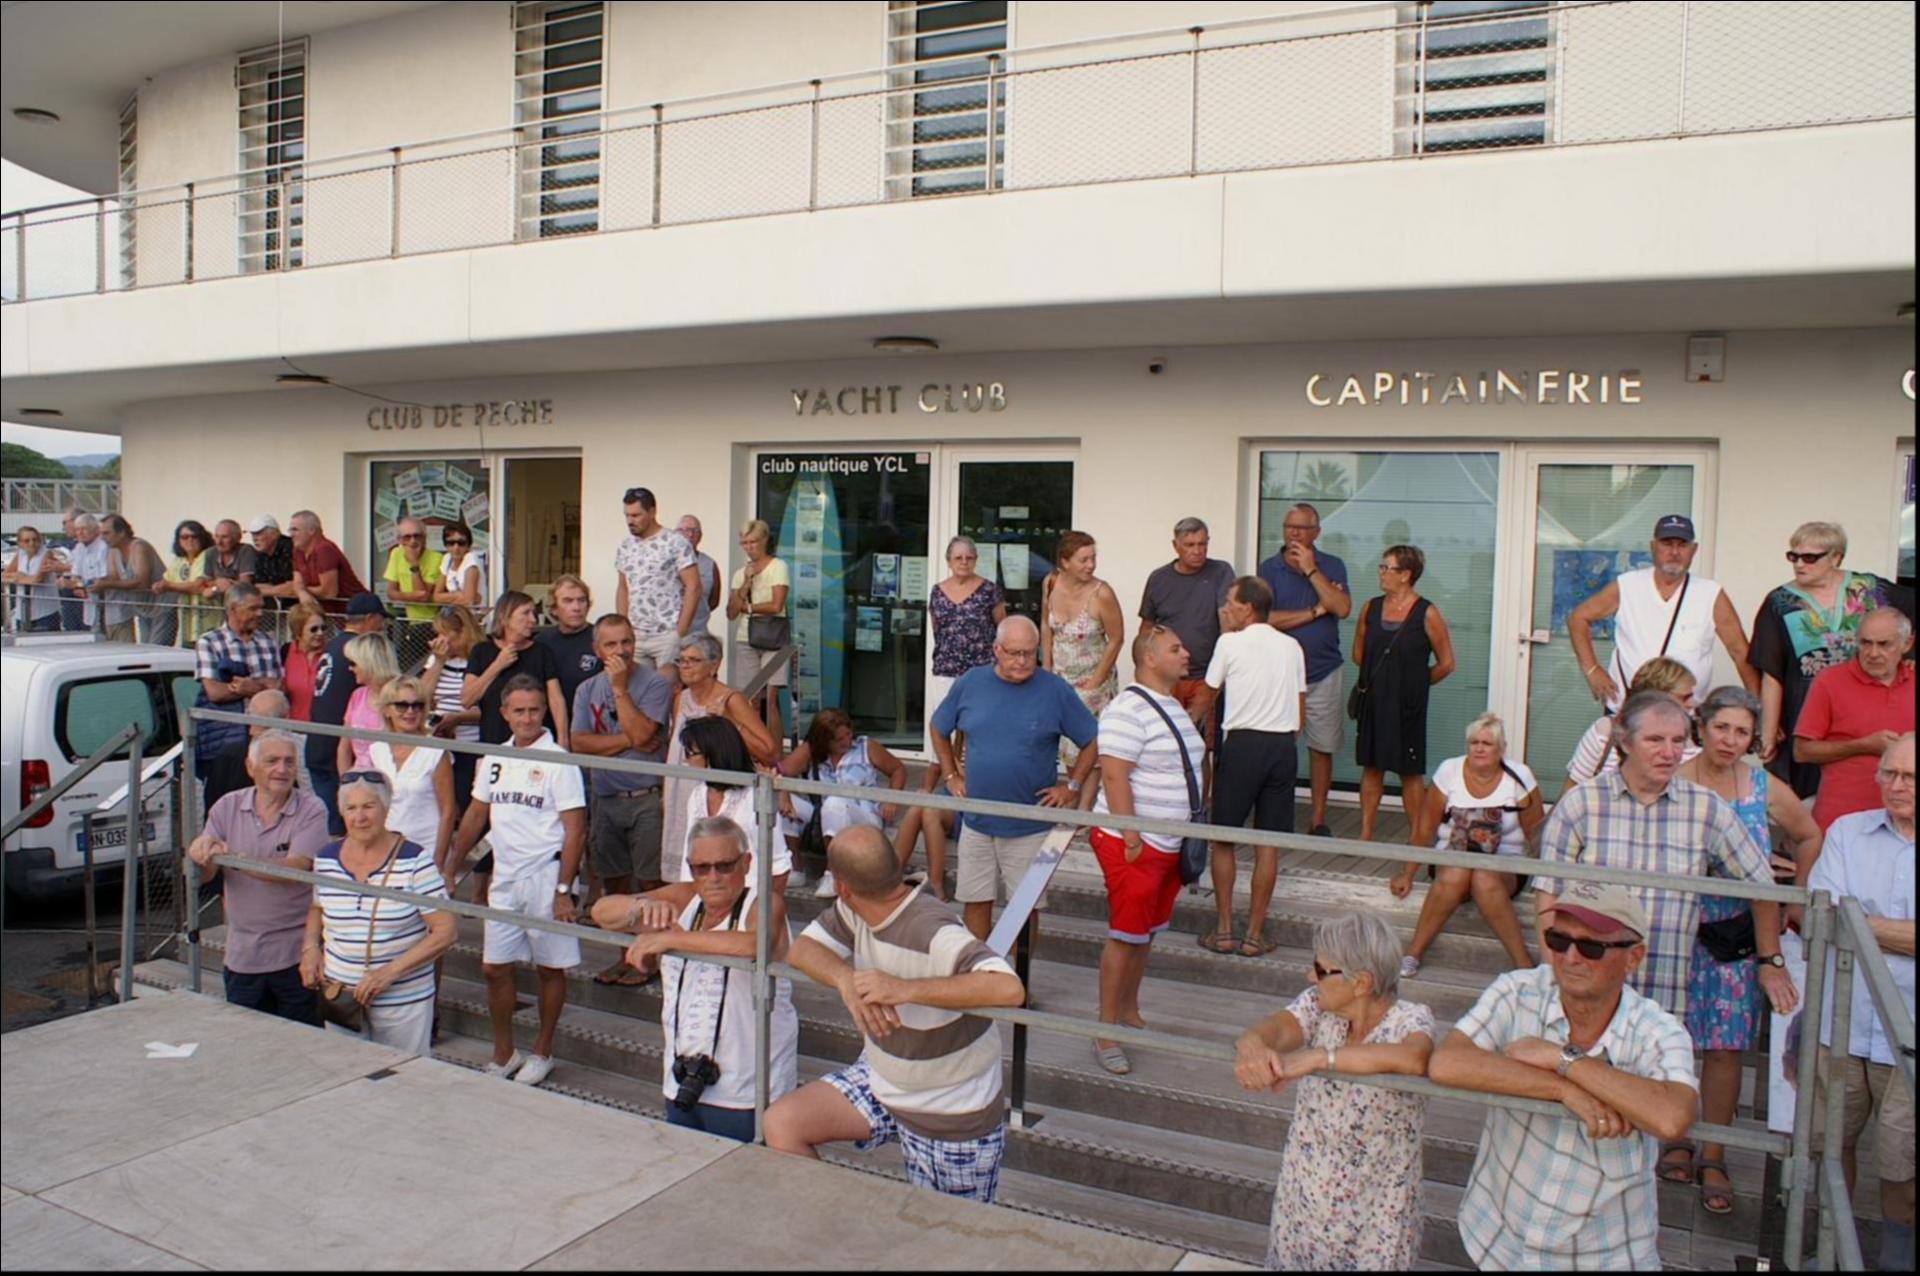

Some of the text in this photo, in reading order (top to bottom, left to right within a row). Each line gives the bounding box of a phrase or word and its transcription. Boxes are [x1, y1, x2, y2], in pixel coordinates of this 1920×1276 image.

[791, 382, 1008, 416] YACHT CLUB
[1305, 369, 1641, 406] CAPITAINERIE
[367, 400, 552, 430] CLUB DE PECHE
[762, 458, 795, 474] club
[800, 457, 868, 475] nautique
[873, 456, 908, 473] YCL
